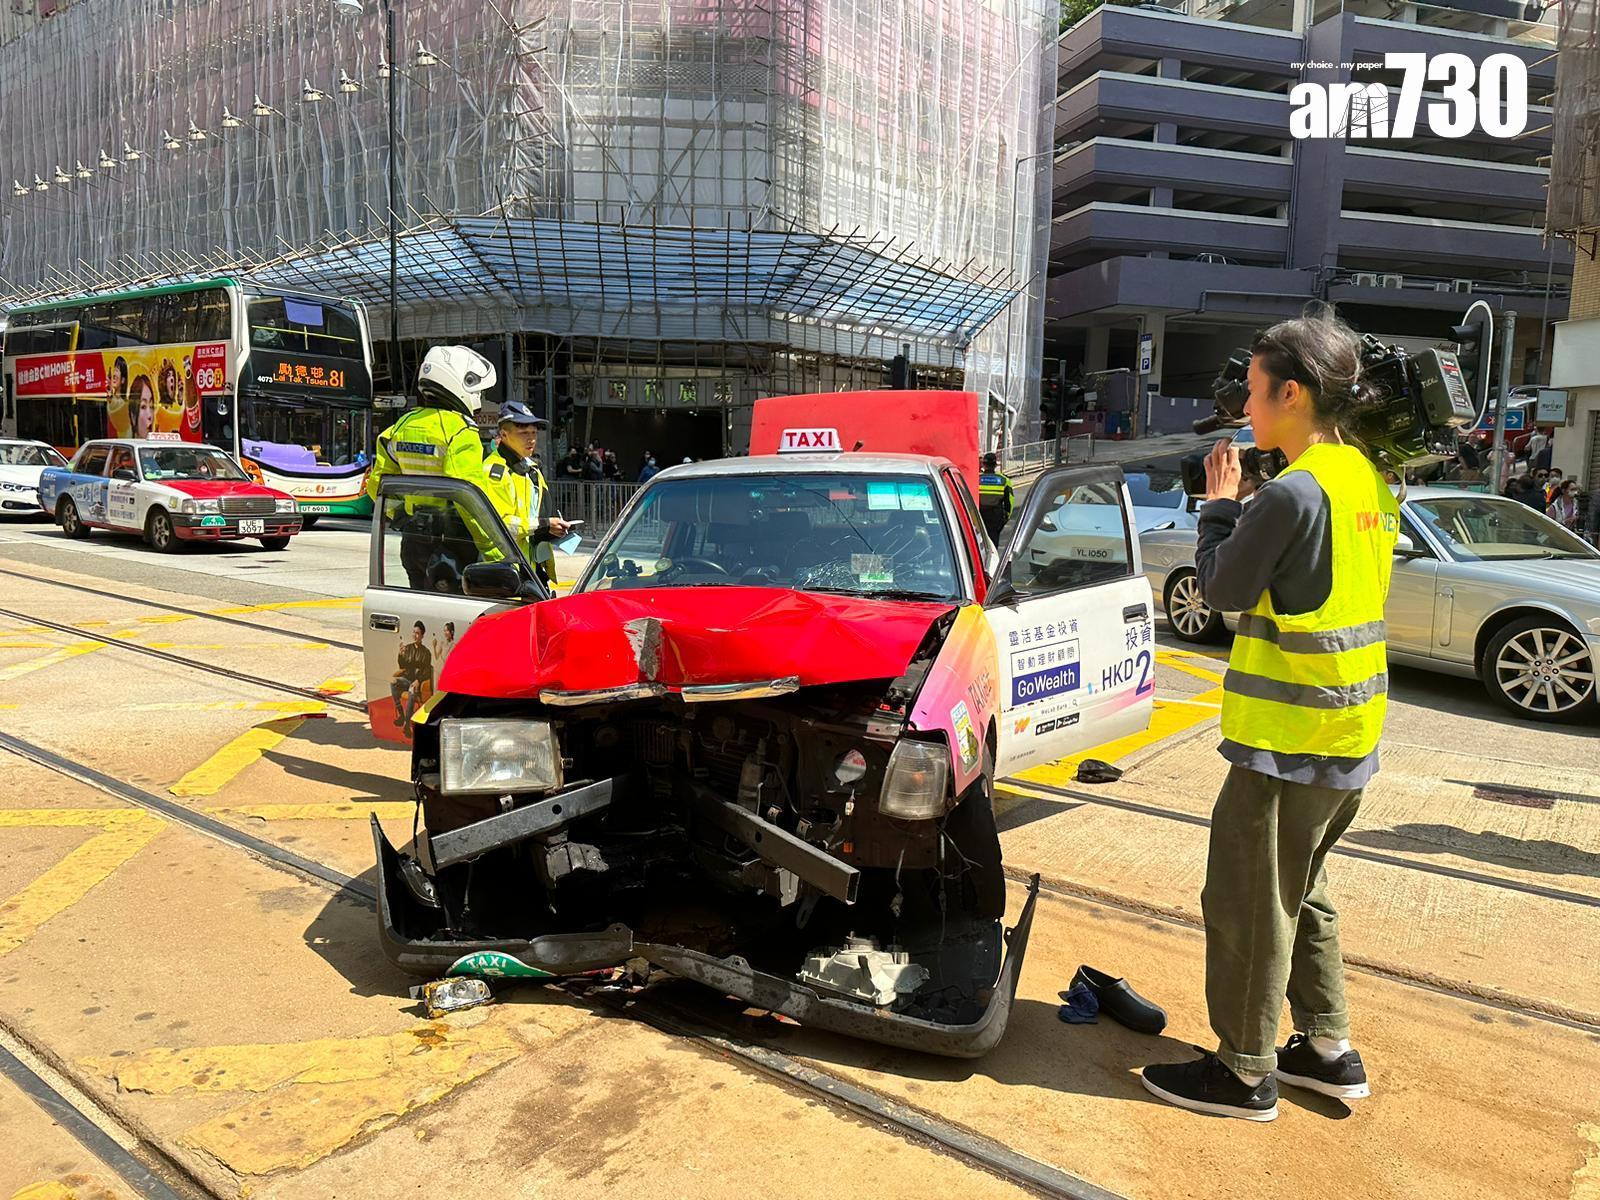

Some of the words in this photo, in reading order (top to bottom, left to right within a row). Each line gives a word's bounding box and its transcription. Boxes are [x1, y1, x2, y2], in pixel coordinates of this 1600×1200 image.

[257, 375, 273, 383] 4073
[329, 370, 344, 388] 81
[398, 443, 425, 453] POLICE
[785, 431, 833, 447] TAXI
[1076, 549, 1087, 557] YL
[1087, 549, 1108, 558] 1050
[1009, 619, 1079, 647] 靈活基金投資
[1125, 621, 1152, 651] 投資
[1017, 646, 1075, 671] 智動理財顧問
[1102, 658, 1134, 691] HKD
[1135, 649, 1152, 696] 2
[1017, 669, 1075, 698] GoWealth
[466, 955, 507, 969] TAXI
